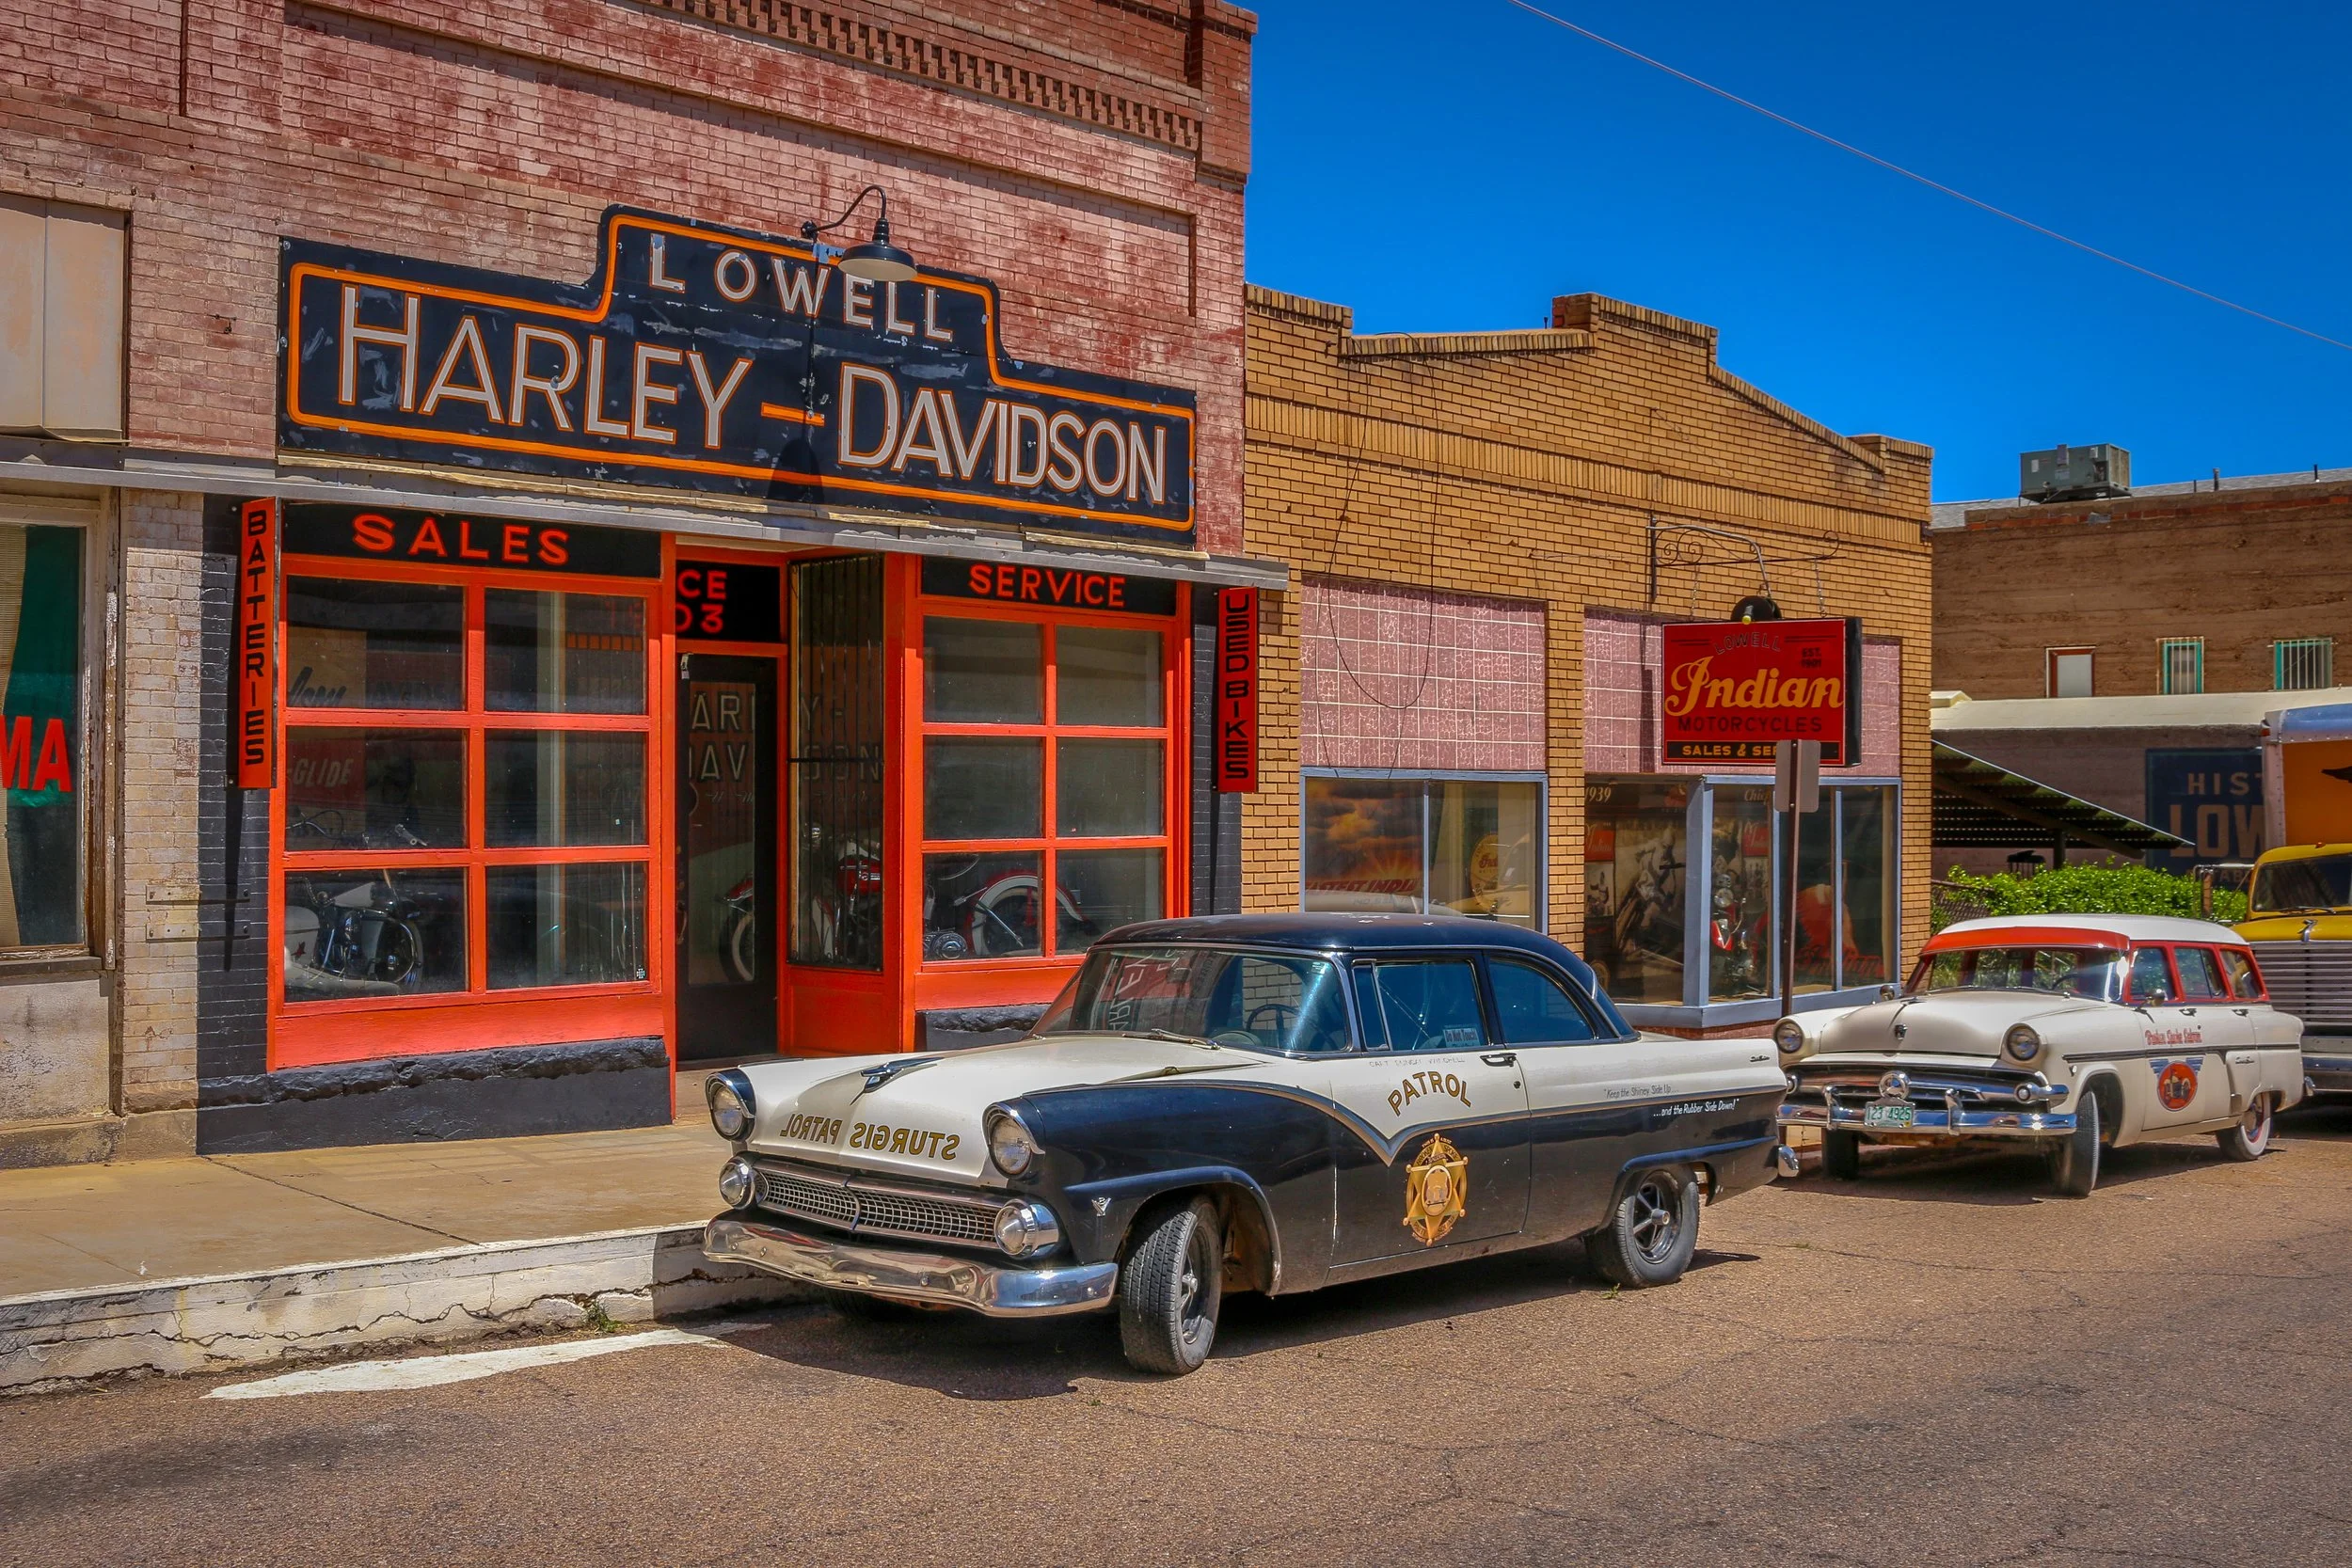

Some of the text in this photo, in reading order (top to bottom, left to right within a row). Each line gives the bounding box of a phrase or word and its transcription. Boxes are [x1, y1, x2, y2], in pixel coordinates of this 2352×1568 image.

[648, 232, 954, 343] LOWELL
[352, 513, 570, 565] SALES
[968, 562, 1126, 609] SERVICE
[246, 509, 267, 767] BATTERIES
[1714, 631, 1782, 656] LOWELL
[1225, 594, 1250, 780] USED BIKES
[1664, 656, 1845, 717] Indian
[1677, 715, 1823, 733] MOTORCYCLES
[1682, 745, 1732, 757] SALES
[1388, 1070, 1472, 1117] PATROL
[1673, 1103, 1684, 1115] the
[1683, 1102, 1704, 1114] Rubber
[1705, 1100, 1718, 1112] Side
